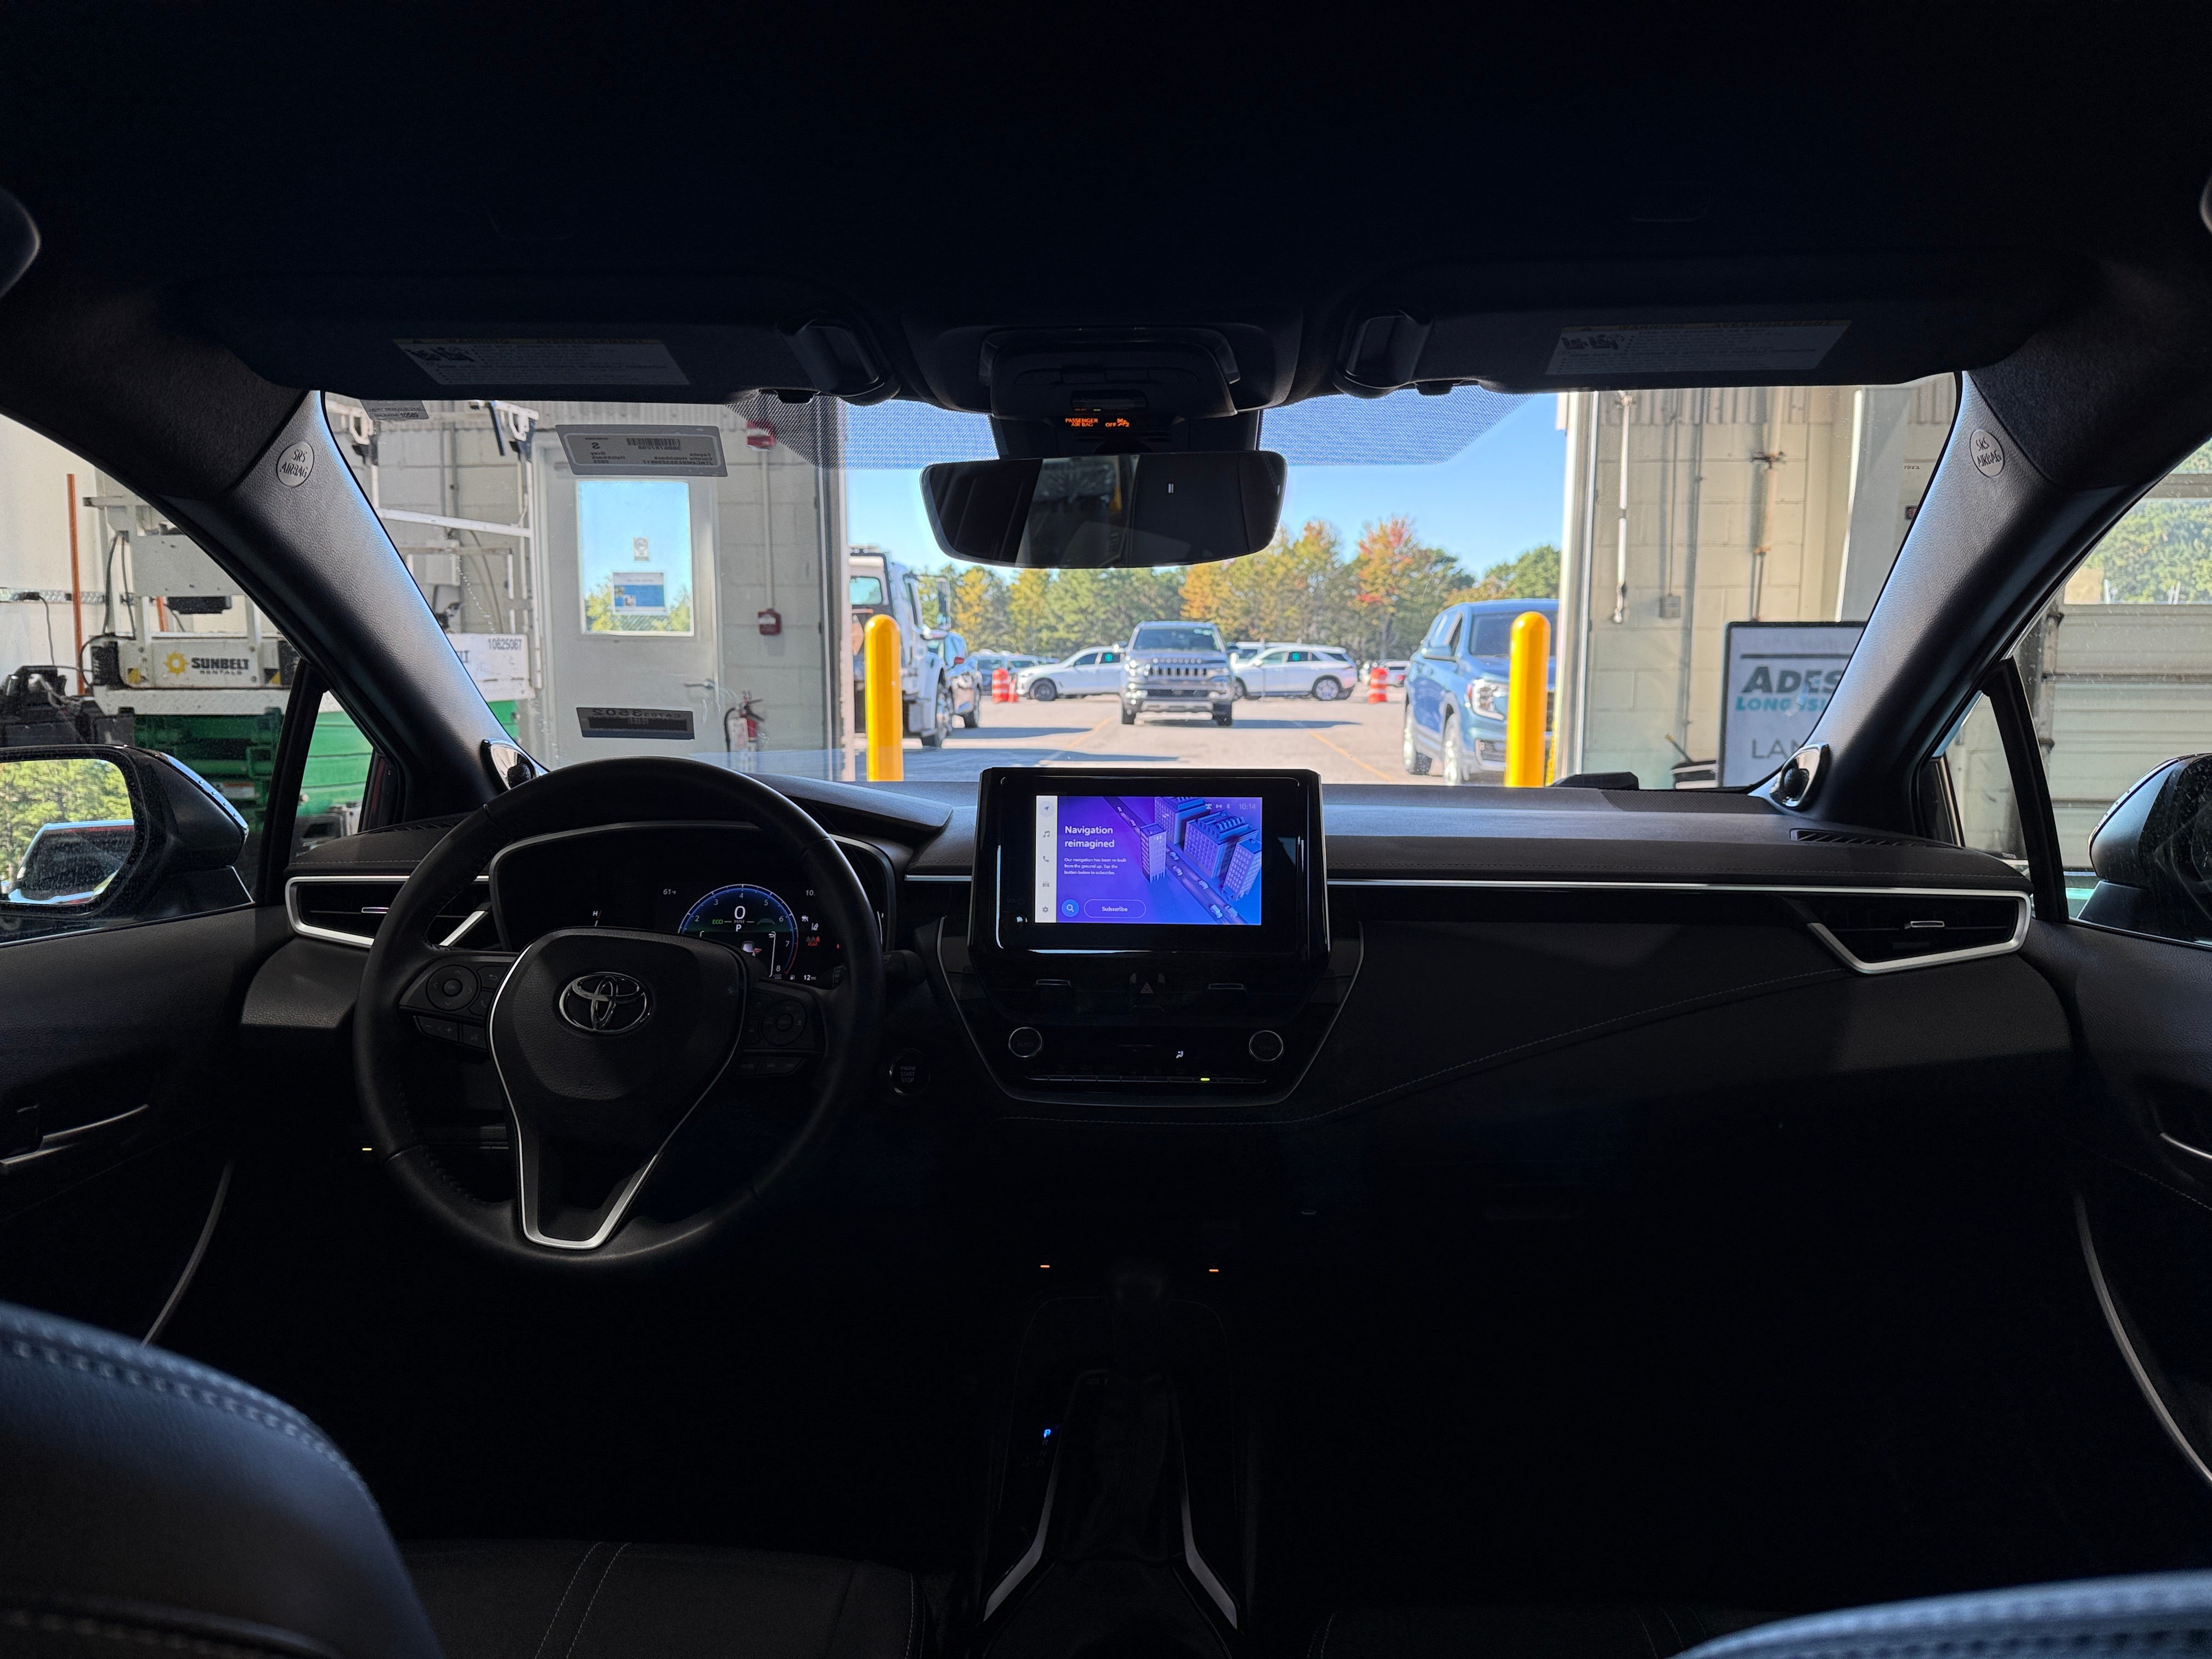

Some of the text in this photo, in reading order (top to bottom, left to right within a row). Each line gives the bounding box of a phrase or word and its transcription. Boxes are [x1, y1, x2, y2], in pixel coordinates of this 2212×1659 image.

[291, 449, 308, 463] SRS
[1977, 450, 2002, 467] AIRBAG
[279, 462, 308, 478] AIRBAG
[191, 657, 249, 670] SUNBELT
[1064, 826, 1114, 836] Navigation
[1064, 839, 1115, 850] reimagined
[1043, 1429, 1052, 1438] P
